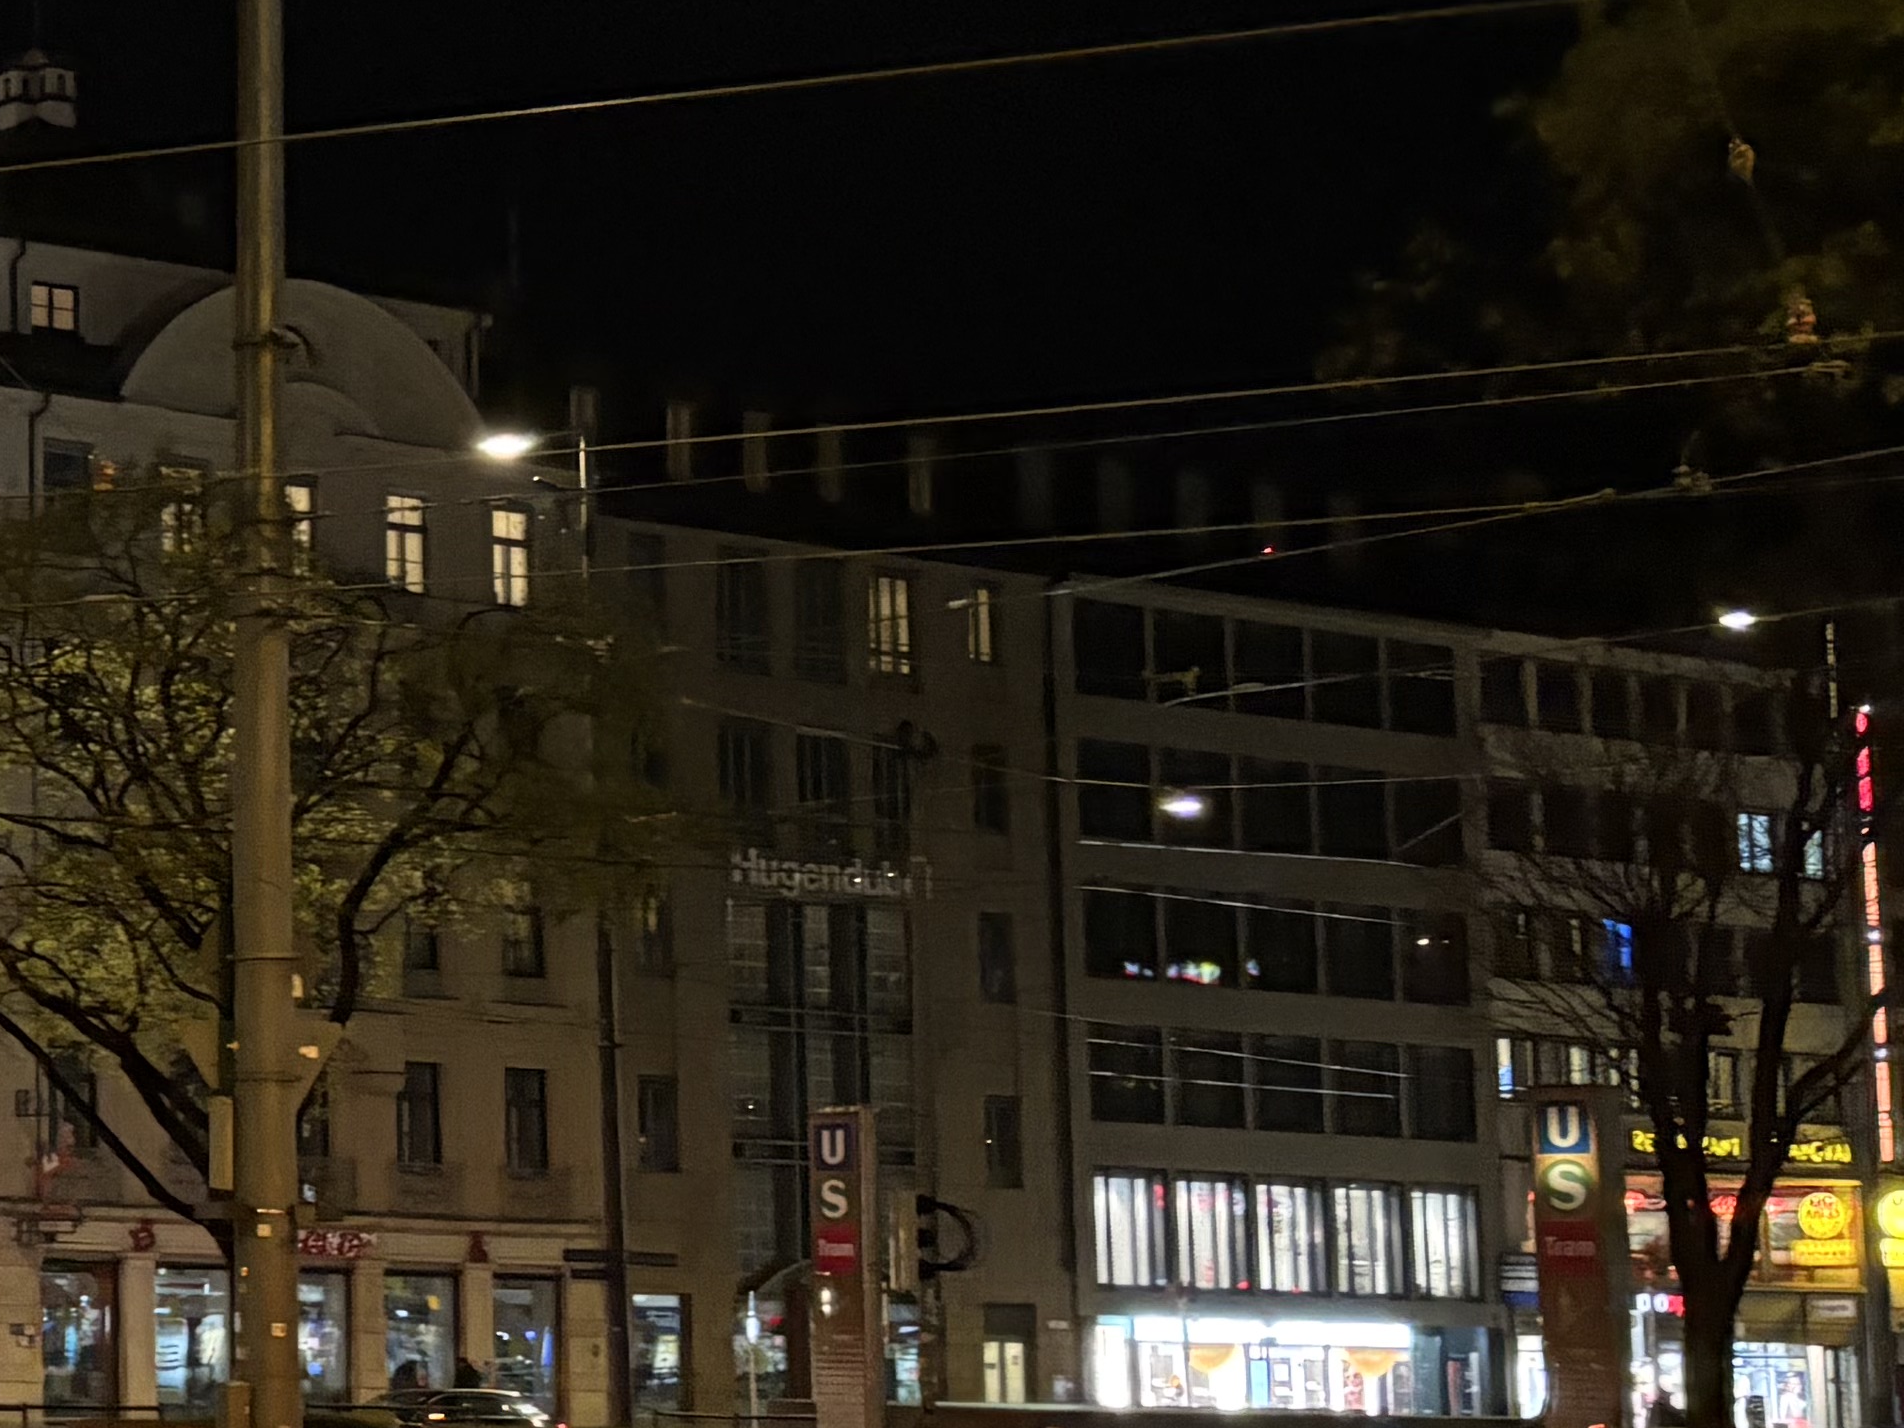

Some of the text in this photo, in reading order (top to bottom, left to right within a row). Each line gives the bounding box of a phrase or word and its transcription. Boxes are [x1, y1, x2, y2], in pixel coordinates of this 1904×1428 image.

[821, 1129, 845, 1165] U
[1547, 1105, 1580, 1148] U
[821, 1179, 848, 1219] S
[1547, 1163, 1586, 1211] S
